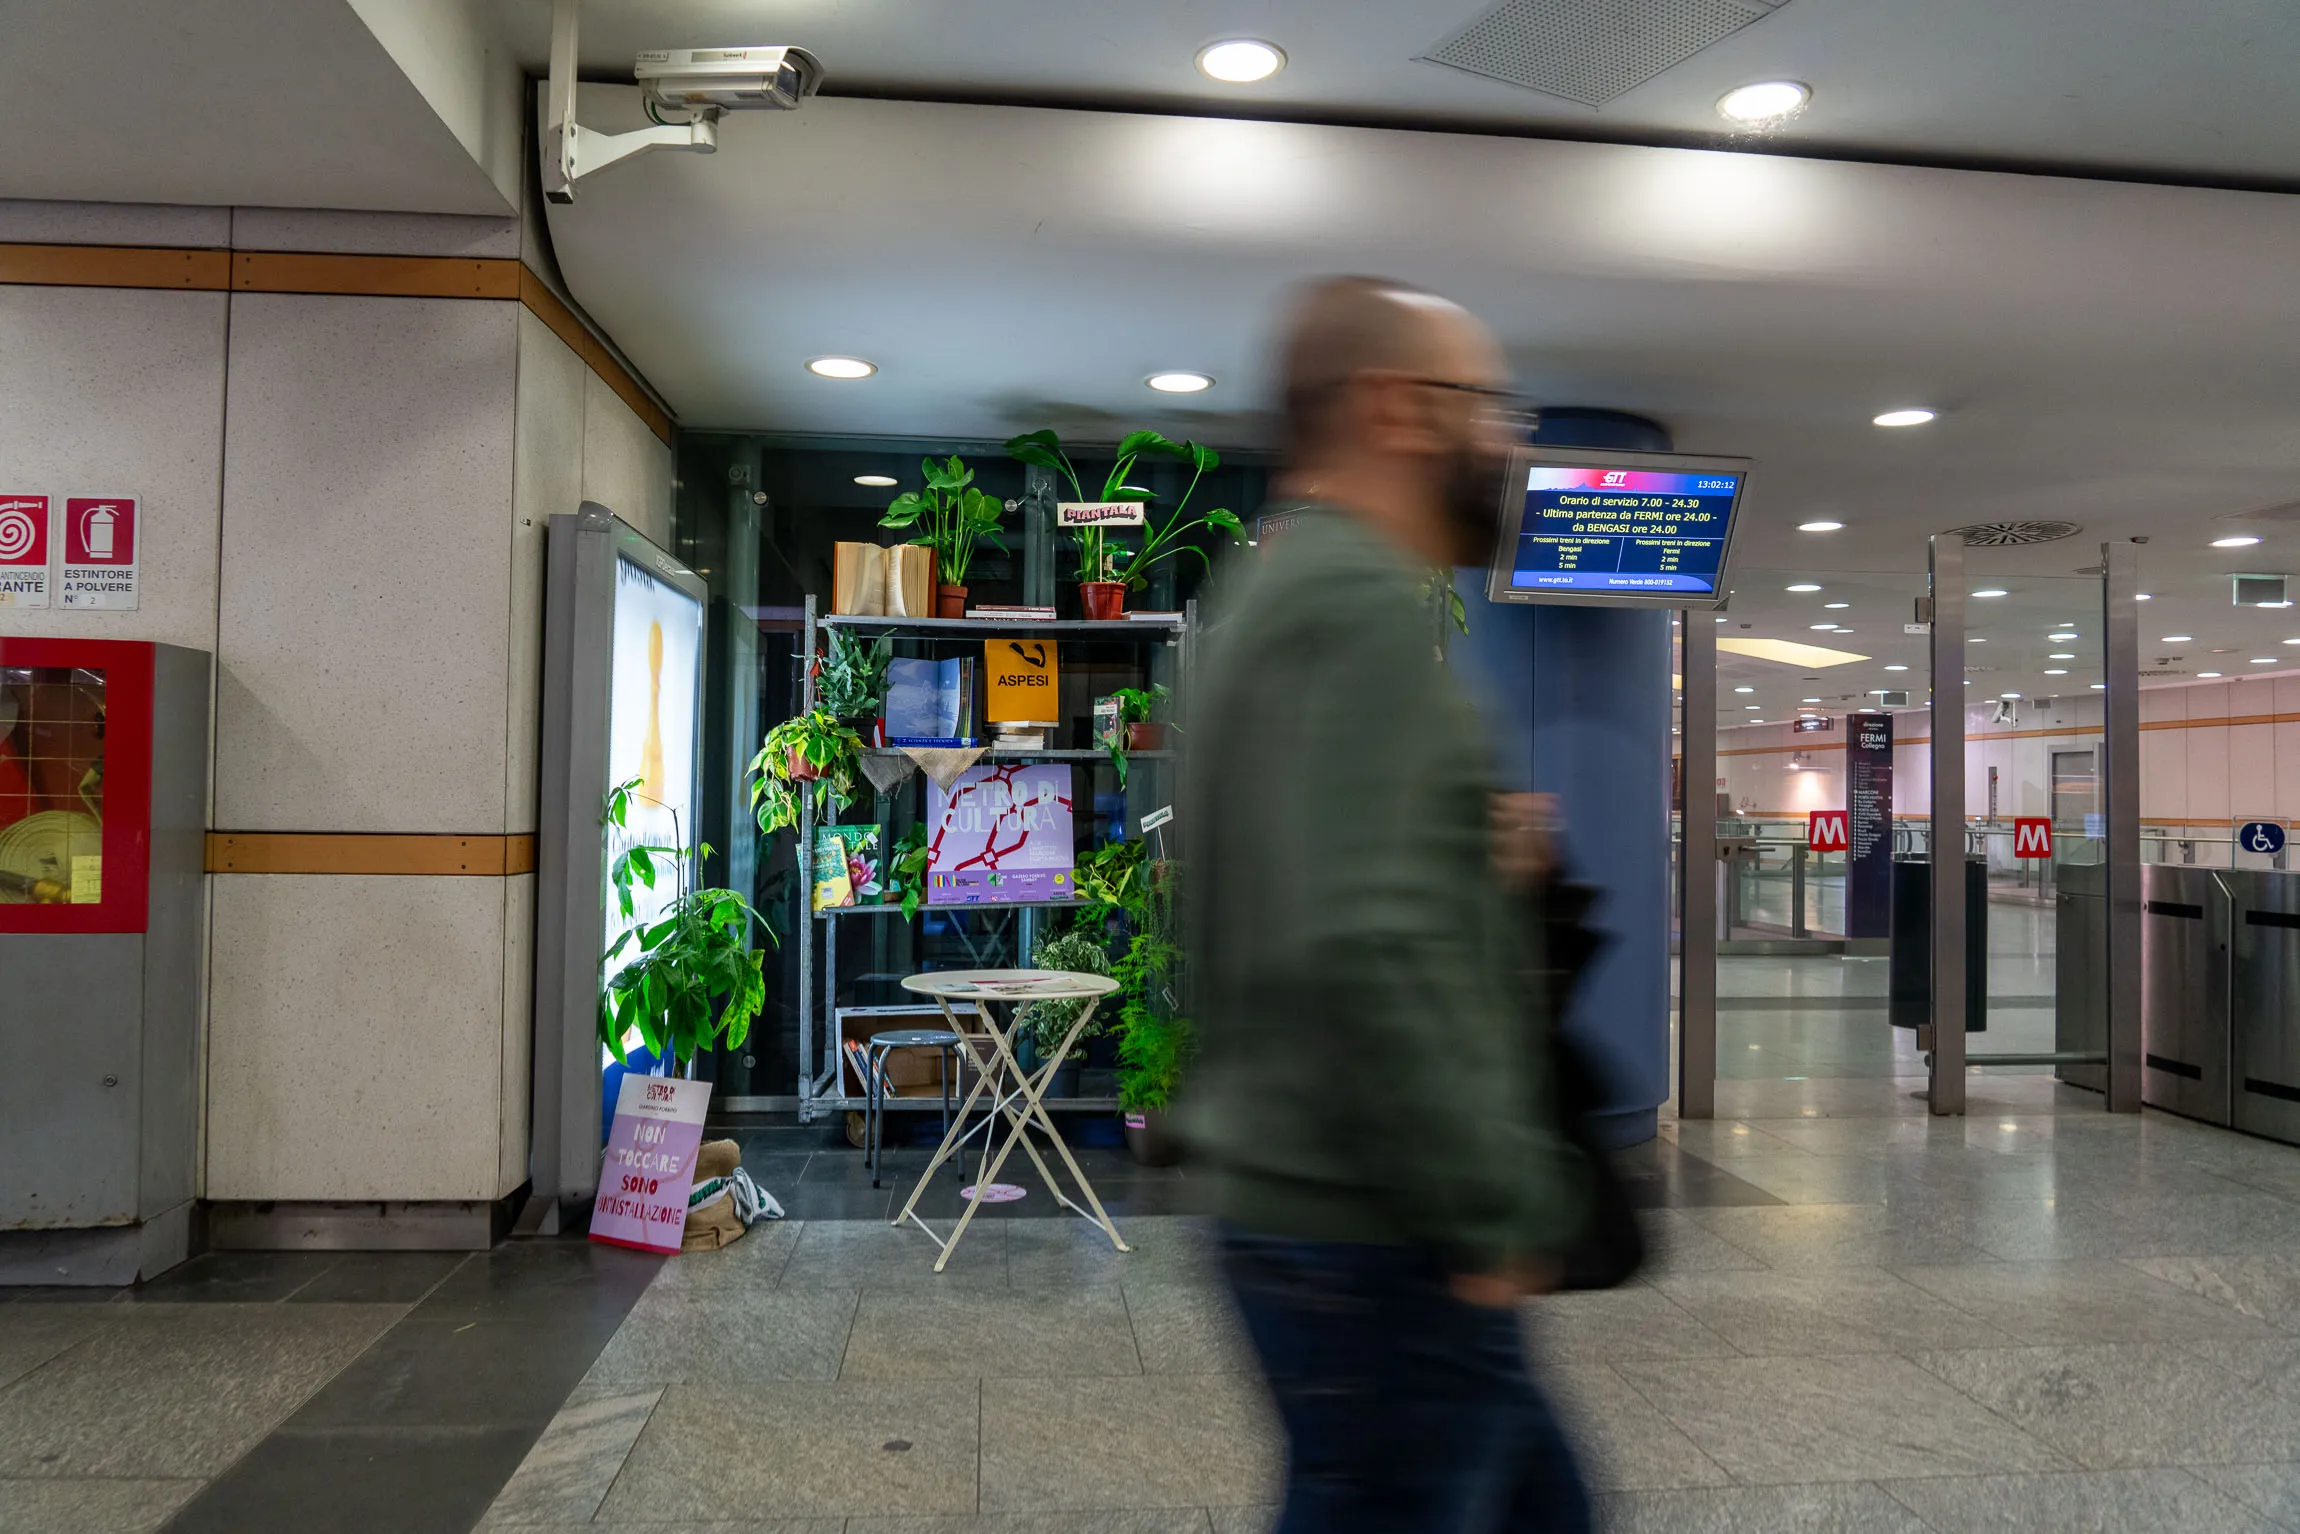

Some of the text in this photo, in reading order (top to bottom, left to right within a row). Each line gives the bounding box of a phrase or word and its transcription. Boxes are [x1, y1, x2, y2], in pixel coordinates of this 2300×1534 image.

[1603, 471, 1627, 484] GTT
[1697, 480, 1735, 489] 13:02:12
[1560, 495, 1589, 505] Orario
[1591, 496, 1601, 506] di
[1602, 497, 1639, 507] servizio
[1641, 498, 1662, 507] 7.00
[1671, 499, 1699, 508] 24.30
[1063, 505, 1137, 523] PIANTALA
[1543, 508, 1574, 518] Ultima
[1576, 510, 1617, 520] partenza
[1619, 511, 1632, 520] da
[1633, 511, 1664, 520] FERMI
[1665, 513, 1682, 521] ore
[1683, 513, 1711, 522] 24.00
[1572, 522, 1585, 532] da
[1587, 523, 1630, 533] BENGASI
[1650, 525, 1677, 534] 24.00
[1582, 537, 1610, 545] direzione
[1558, 545, 1582, 553] Bengasi
[64, 569, 133, 580] ESTINTORE
[64, 582, 133, 592] A POLVERE
[90, 596, 96, 605] 2
[998, 674, 1049, 688] ASPESI
[1860, 733, 1887, 743] FERMI
[1861, 742, 1885, 750] Collegno
[938, 780, 1059, 808] METRO DI
[940, 806, 1057, 833] CULTURA
[1812, 817, 1846, 844] M
[2016, 824, 2049, 851] M
[634, 1123, 666, 1145] NON
[618, 1148, 680, 1174] TOCCARE
[621, 1173, 658, 1196] SONO
